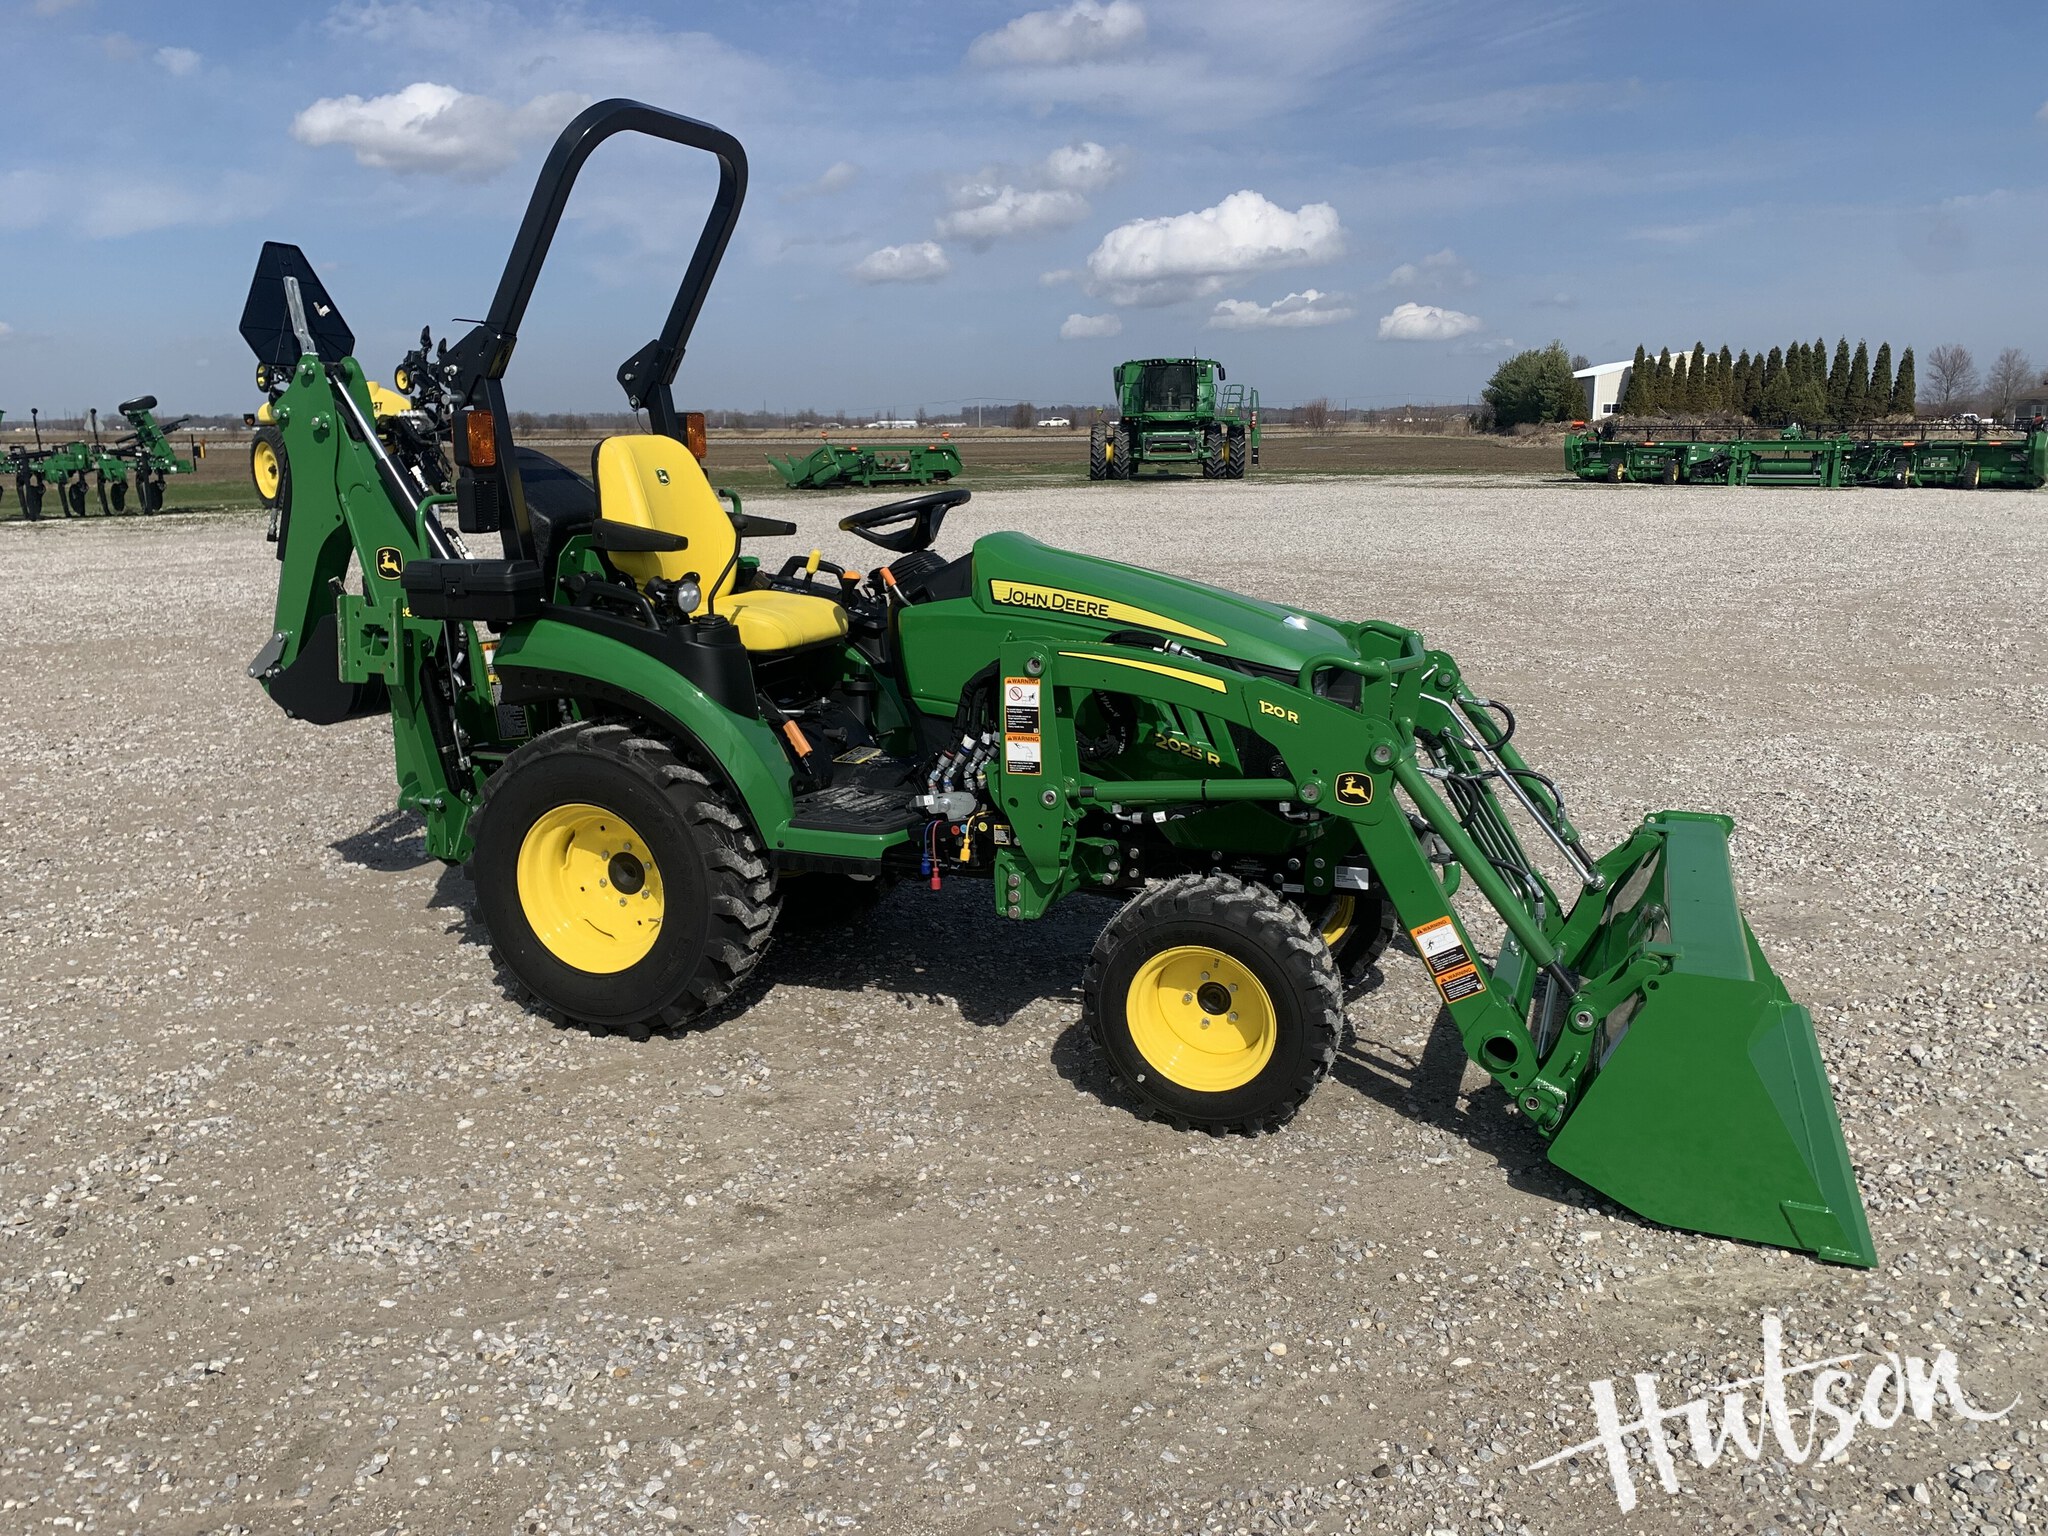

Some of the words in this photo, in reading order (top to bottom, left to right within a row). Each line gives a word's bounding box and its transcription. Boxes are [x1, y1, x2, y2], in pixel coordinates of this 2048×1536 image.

[1003, 587, 1048, 607] JOHN
[1052, 593, 1109, 616] DEERE
[1258, 699, 1286, 718] 120
[1287, 710, 1299, 724] R
[1012, 735, 1040, 743] WARNING
[1155, 733, 1203, 760] 2025
[1207, 752, 1221, 768] R
[1421, 919, 1448, 932] WARNING
[1447, 967, 1473, 980] WARNING
